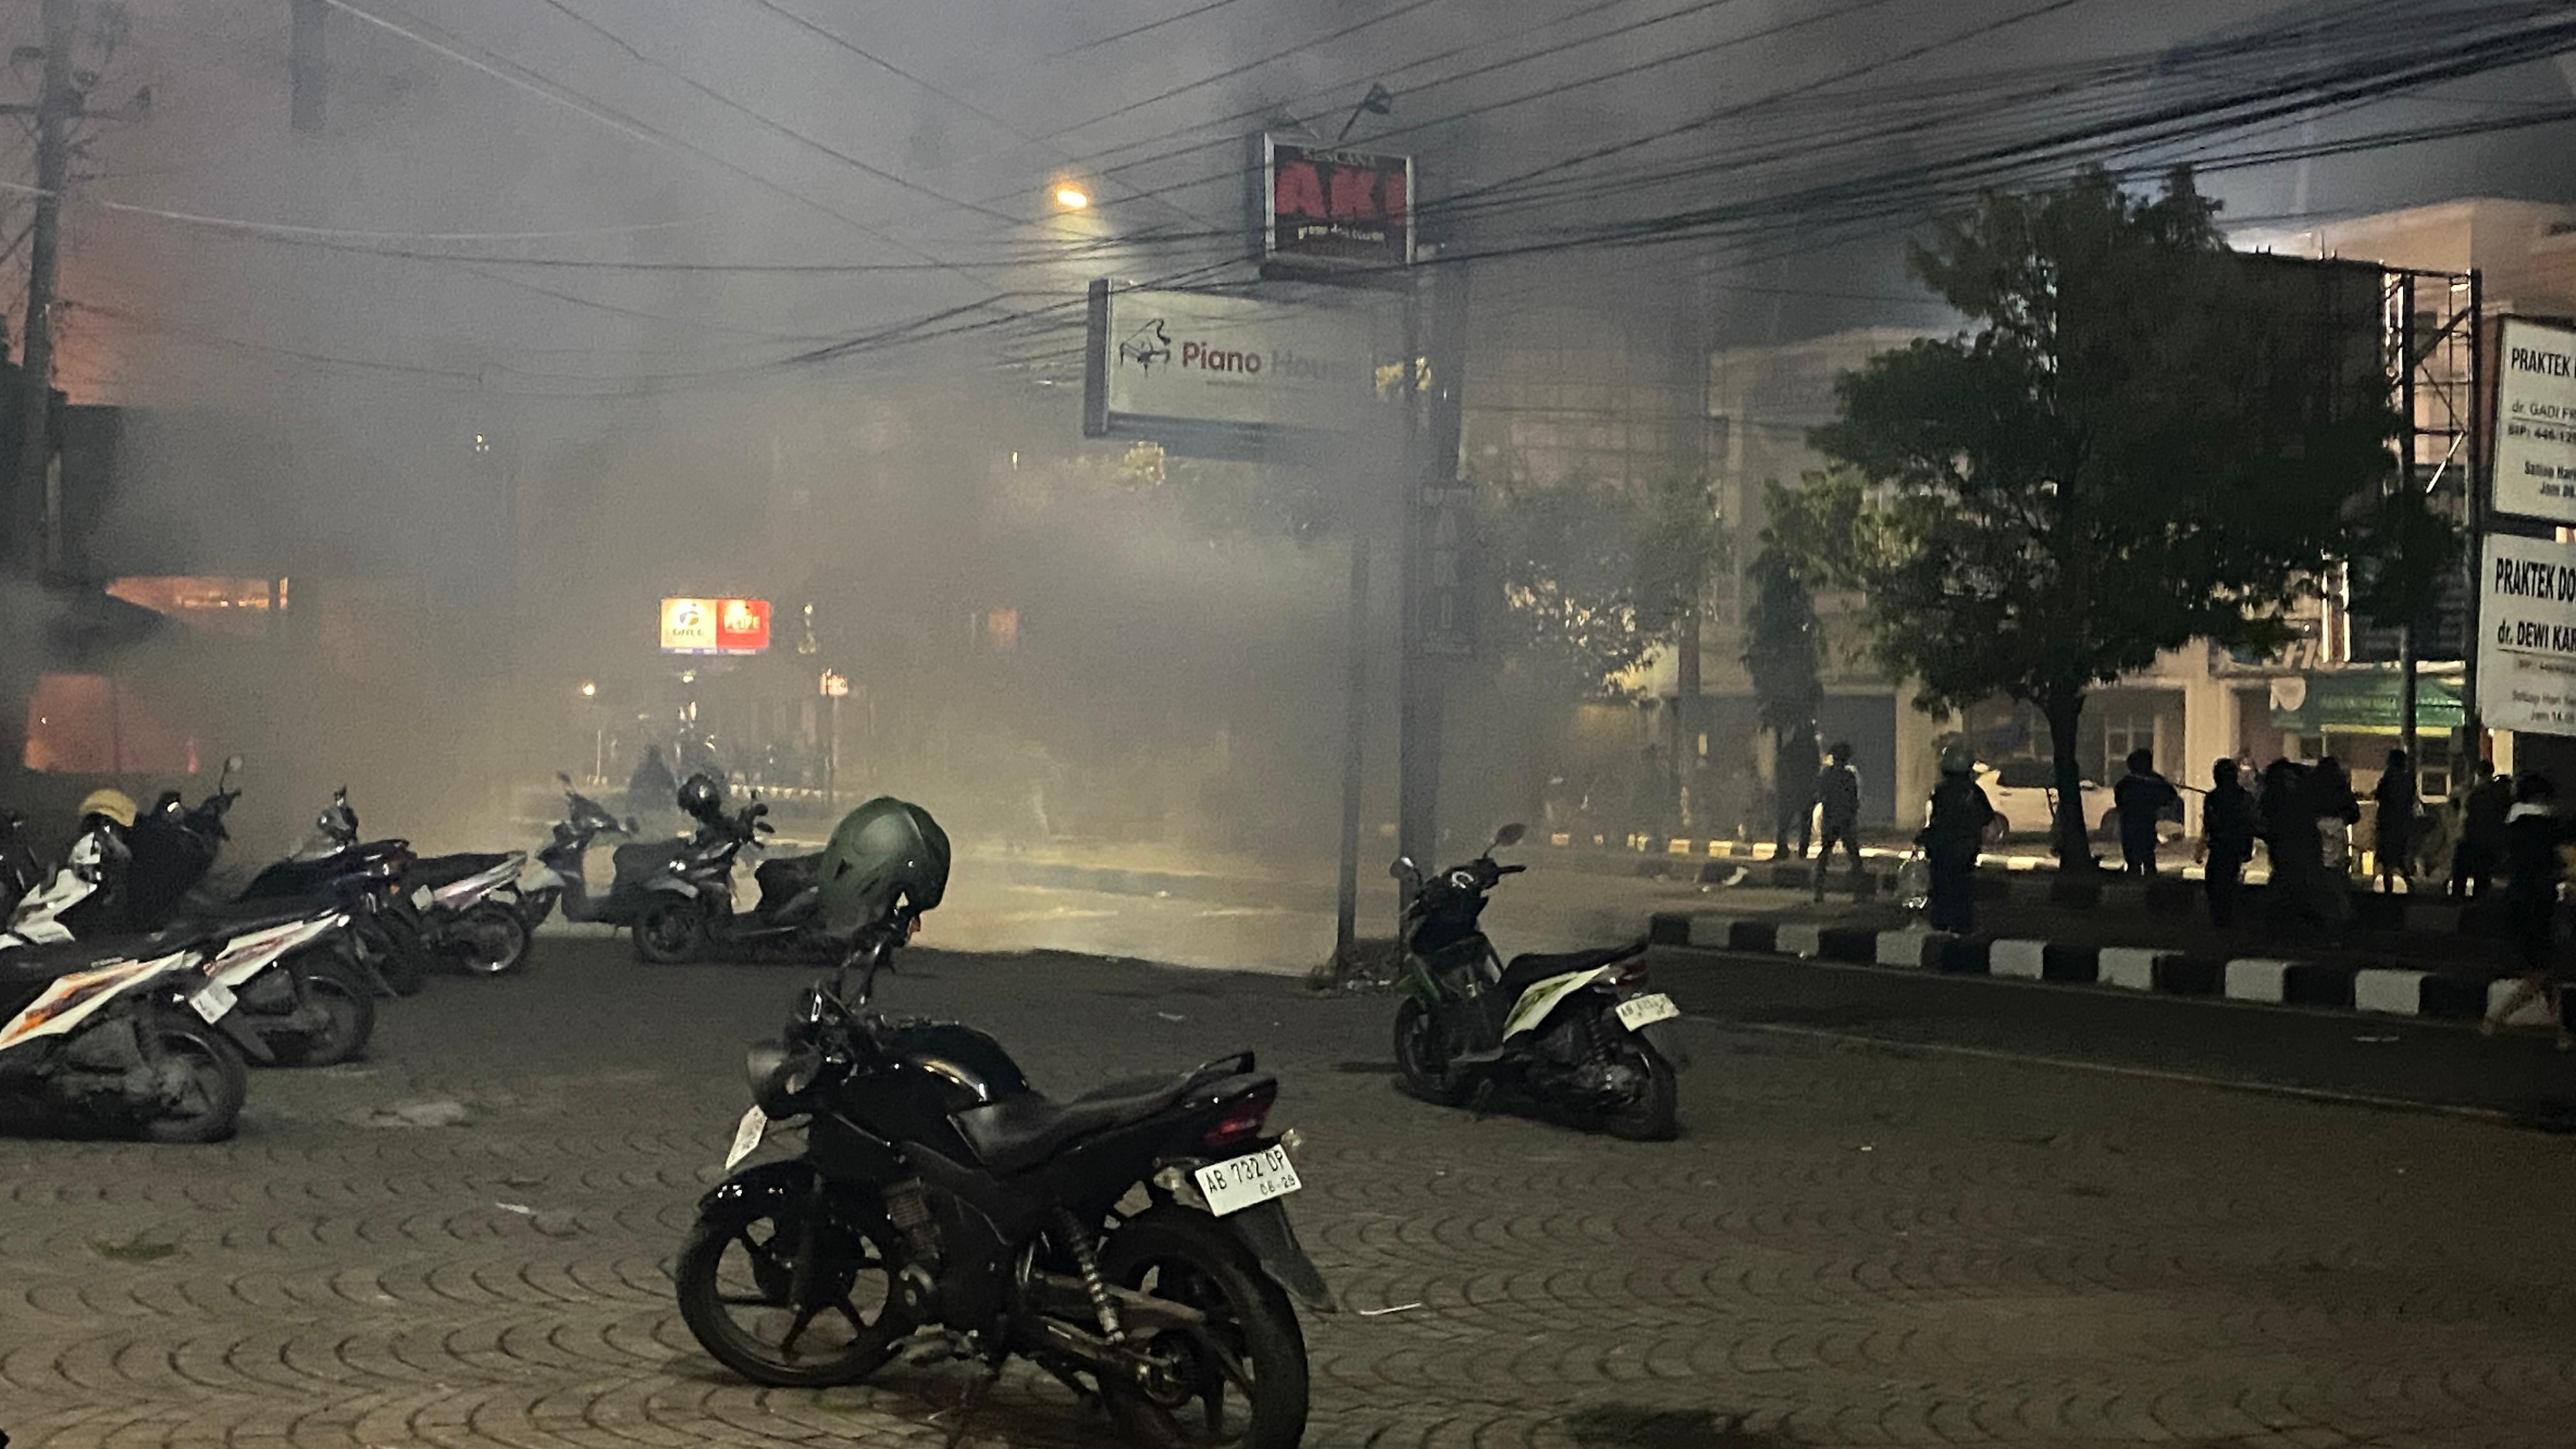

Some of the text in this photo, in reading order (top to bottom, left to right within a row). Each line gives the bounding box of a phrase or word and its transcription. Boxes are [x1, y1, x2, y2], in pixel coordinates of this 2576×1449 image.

[1182, 341, 1262, 373] Piano
[2511, 347, 2571, 378] PRAKTEK
[2496, 558, 2556, 599] PRAKTEK
[2517, 621, 2549, 649] DEWI
[1206, 1150, 1284, 1194] AB 732 DP
